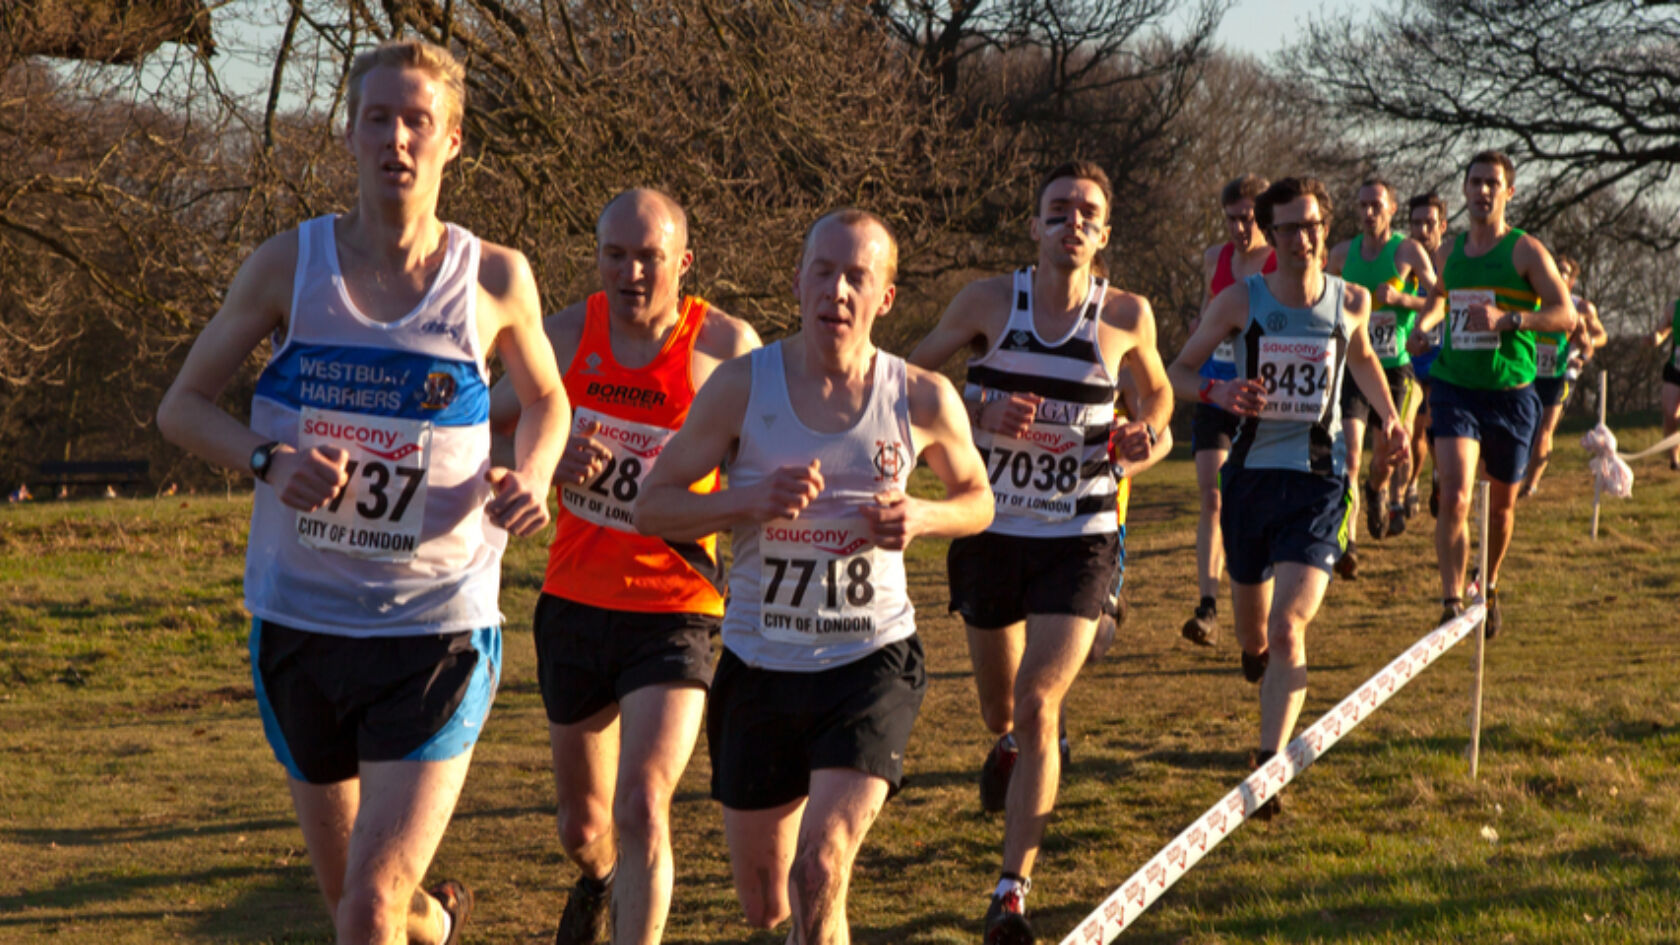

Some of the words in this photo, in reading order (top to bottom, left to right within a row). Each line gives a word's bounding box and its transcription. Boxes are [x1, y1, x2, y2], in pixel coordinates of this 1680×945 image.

[1369, 325, 1394, 344] 97
[1263, 343, 1319, 355] saucony
[301, 356, 410, 386] WESTBUY
[1261, 361, 1330, 398] 8434
[300, 381, 401, 410] HARRIERS
[586, 382, 667, 406] BORDER
[304, 419, 399, 448] saucony
[991, 446, 1078, 493] 7038
[564, 488, 585, 507] CITY
[588, 500, 602, 513] OF
[1011, 495, 1024, 506] OF
[1027, 497, 1071, 513] LONDON
[299, 516, 331, 539] CITY
[330, 526, 345, 543] OF
[350, 528, 415, 552] LONDON
[765, 527, 849, 546] saucony
[764, 556, 874, 608] 7718
[764, 613, 792, 629] CITY
[796, 616, 811, 631] OF
[816, 615, 872, 634] LONDON
